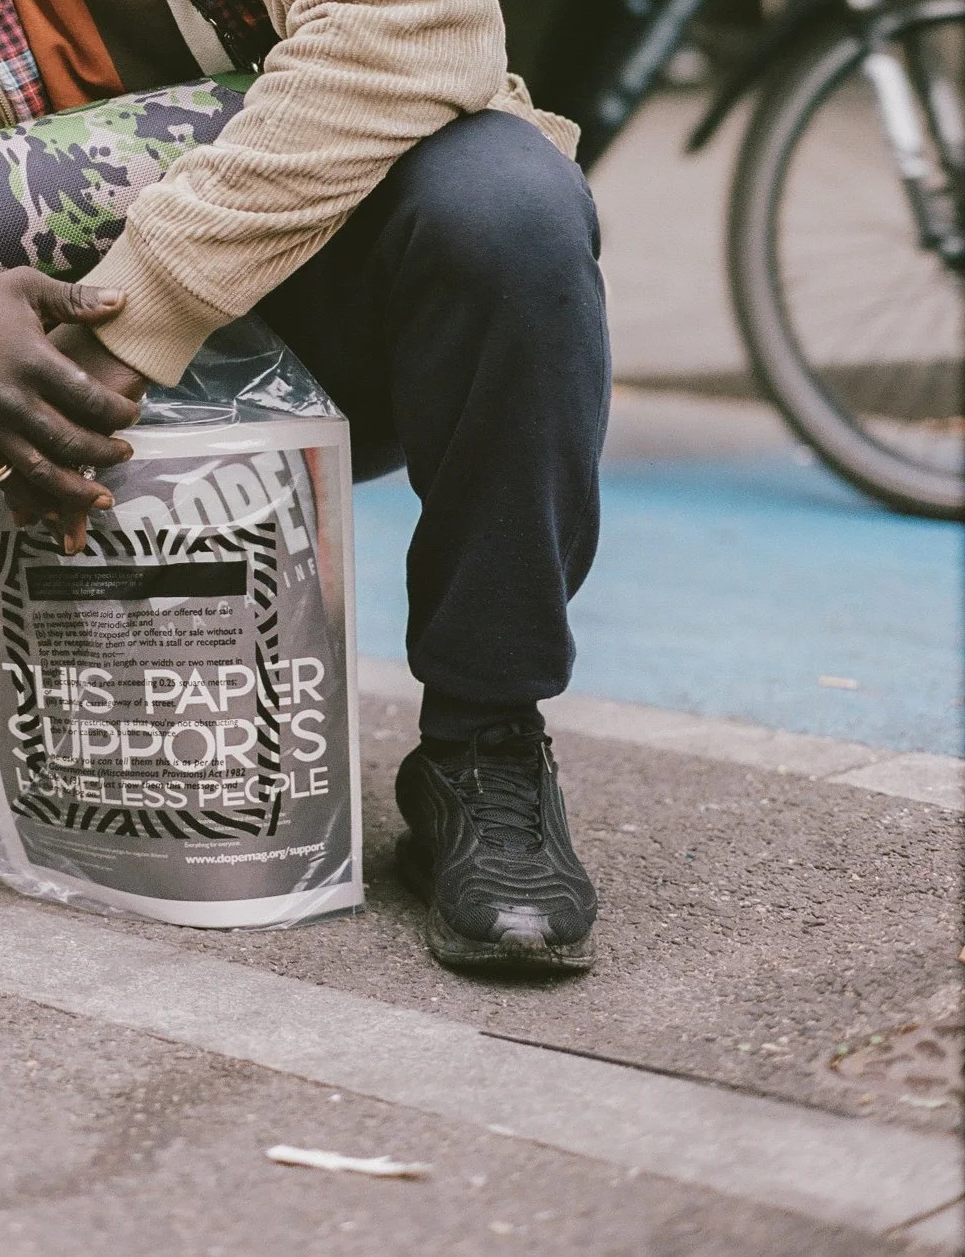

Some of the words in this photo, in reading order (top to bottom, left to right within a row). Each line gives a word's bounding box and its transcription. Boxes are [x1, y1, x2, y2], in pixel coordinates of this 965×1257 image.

[128, 608, 160, 620] exposed
[174, 608, 202, 616] offered
[205, 607, 217, 616] for
[219, 607, 233, 615] sale
[139, 619, 153, 627] and
[144, 628, 172, 637] offered
[175, 627, 187, 636] for
[189, 627, 205, 636] sale
[206, 627, 237, 635] without
[139, 639, 157, 647] with
[166, 639, 182, 647] stall
[196, 638, 237, 648] receptacle
[112, 658, 137, 668] length
[151, 658, 174, 667] width
[206, 658, 233, 666] metres
[236, 657, 243, 665] in
[118, 679, 158, 689] exceeding
[159, 678, 176, 687] 0.25
[178, 680, 205, 690] square
[144, 657, 325, 715] PAPER
[133, 697, 143, 706] of
[132, 718, 148, 726] that
[151, 718, 175, 728] you're
[178, 719, 192, 727] not
[194, 718, 239, 728] obstructing
[8, 709, 328, 771] SUPPORTS
[115, 756, 129, 765] tell
[131, 757, 153, 766] them
[155, 757, 171, 766] this
[173, 758, 179, 766] is
[194, 759, 209, 768] per
[211, 757, 225, 766] the
[161, 768, 207, 778] Provisions)
[208, 769, 223, 778] Act
[225, 768, 246, 777] 1982
[184, 781, 219, 791] message
[222, 781, 238, 789] and
[198, 766, 329, 807] PEOPLE
[185, 842, 326, 865] www.dopemag.org/support
